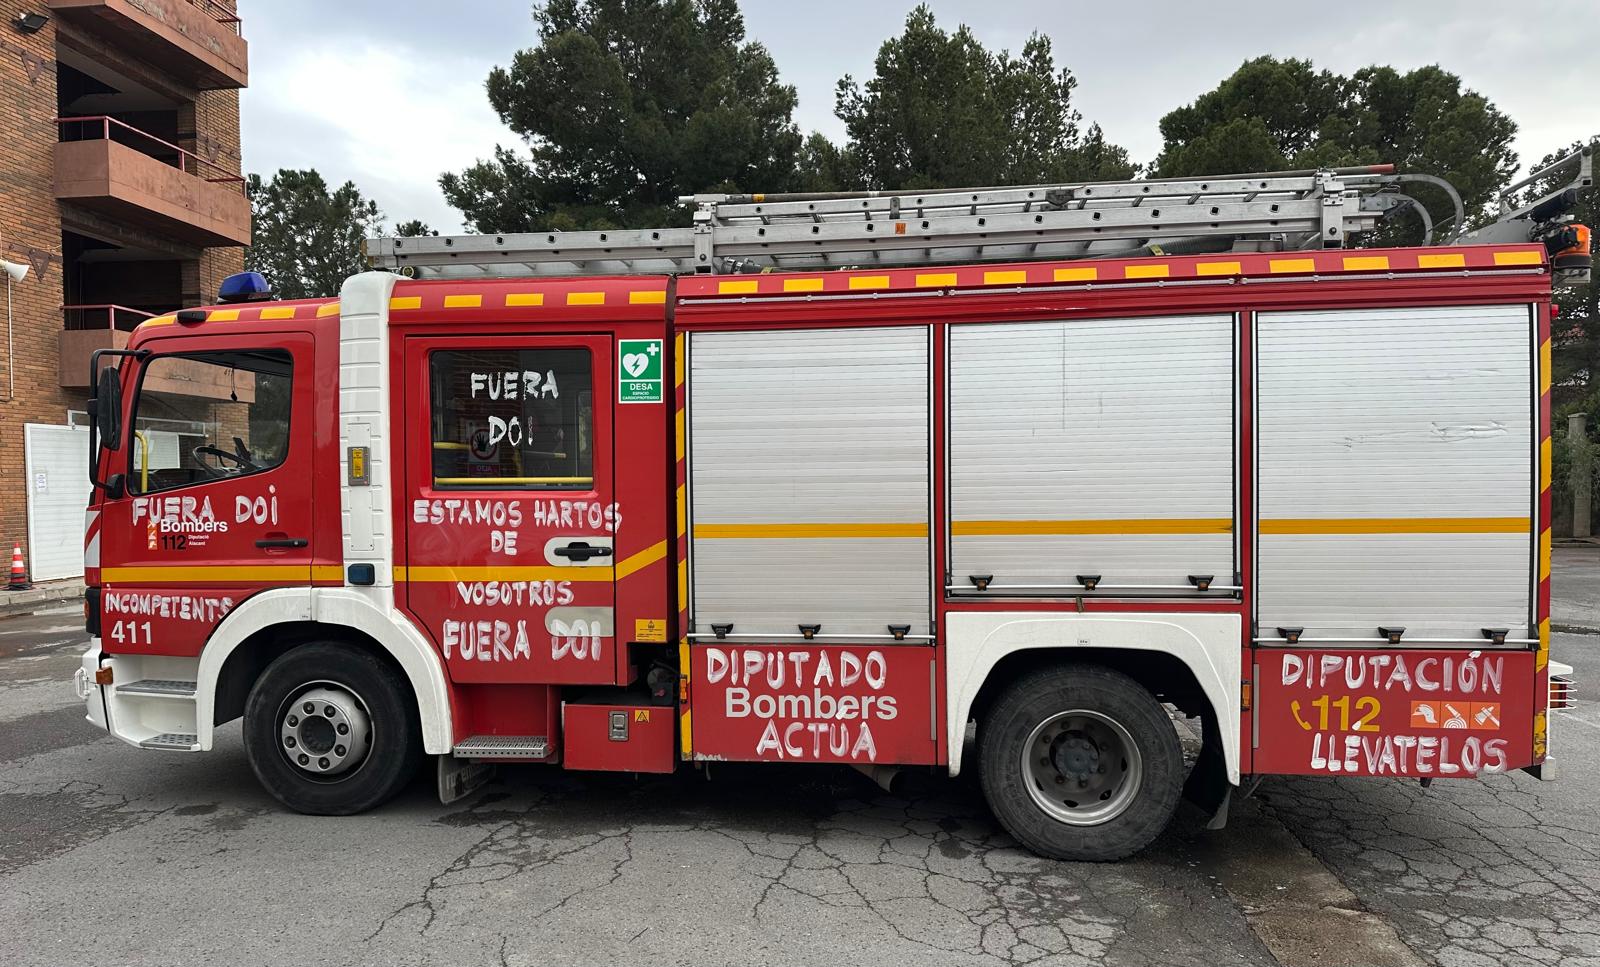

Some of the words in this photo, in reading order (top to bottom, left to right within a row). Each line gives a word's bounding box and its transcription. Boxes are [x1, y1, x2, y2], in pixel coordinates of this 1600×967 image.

[470, 371, 560, 400] FUERA
[132, 496, 214, 526] FUERA
[161, 519, 227, 532] Bombers
[413, 500, 522, 527] ESTAMOS
[534, 500, 622, 532] HARTOS
[161, 535, 186, 550] 112
[491, 530, 518, 555] DE
[457, 580, 575, 606] VOSOTROS
[111, 620, 151, 644] 411
[443, 619, 531, 662] FUERA
[551, 619, 603, 662] DOI
[706, 648, 887, 688] DIPUTADO
[1282, 650, 1503, 694] DIPUTACIÓN
[725, 687, 898, 721] Bombers
[1311, 695, 1381, 732] 112
[757, 719, 876, 762] ACTUA
[1310, 732, 1508, 775] LLEVATELOS
